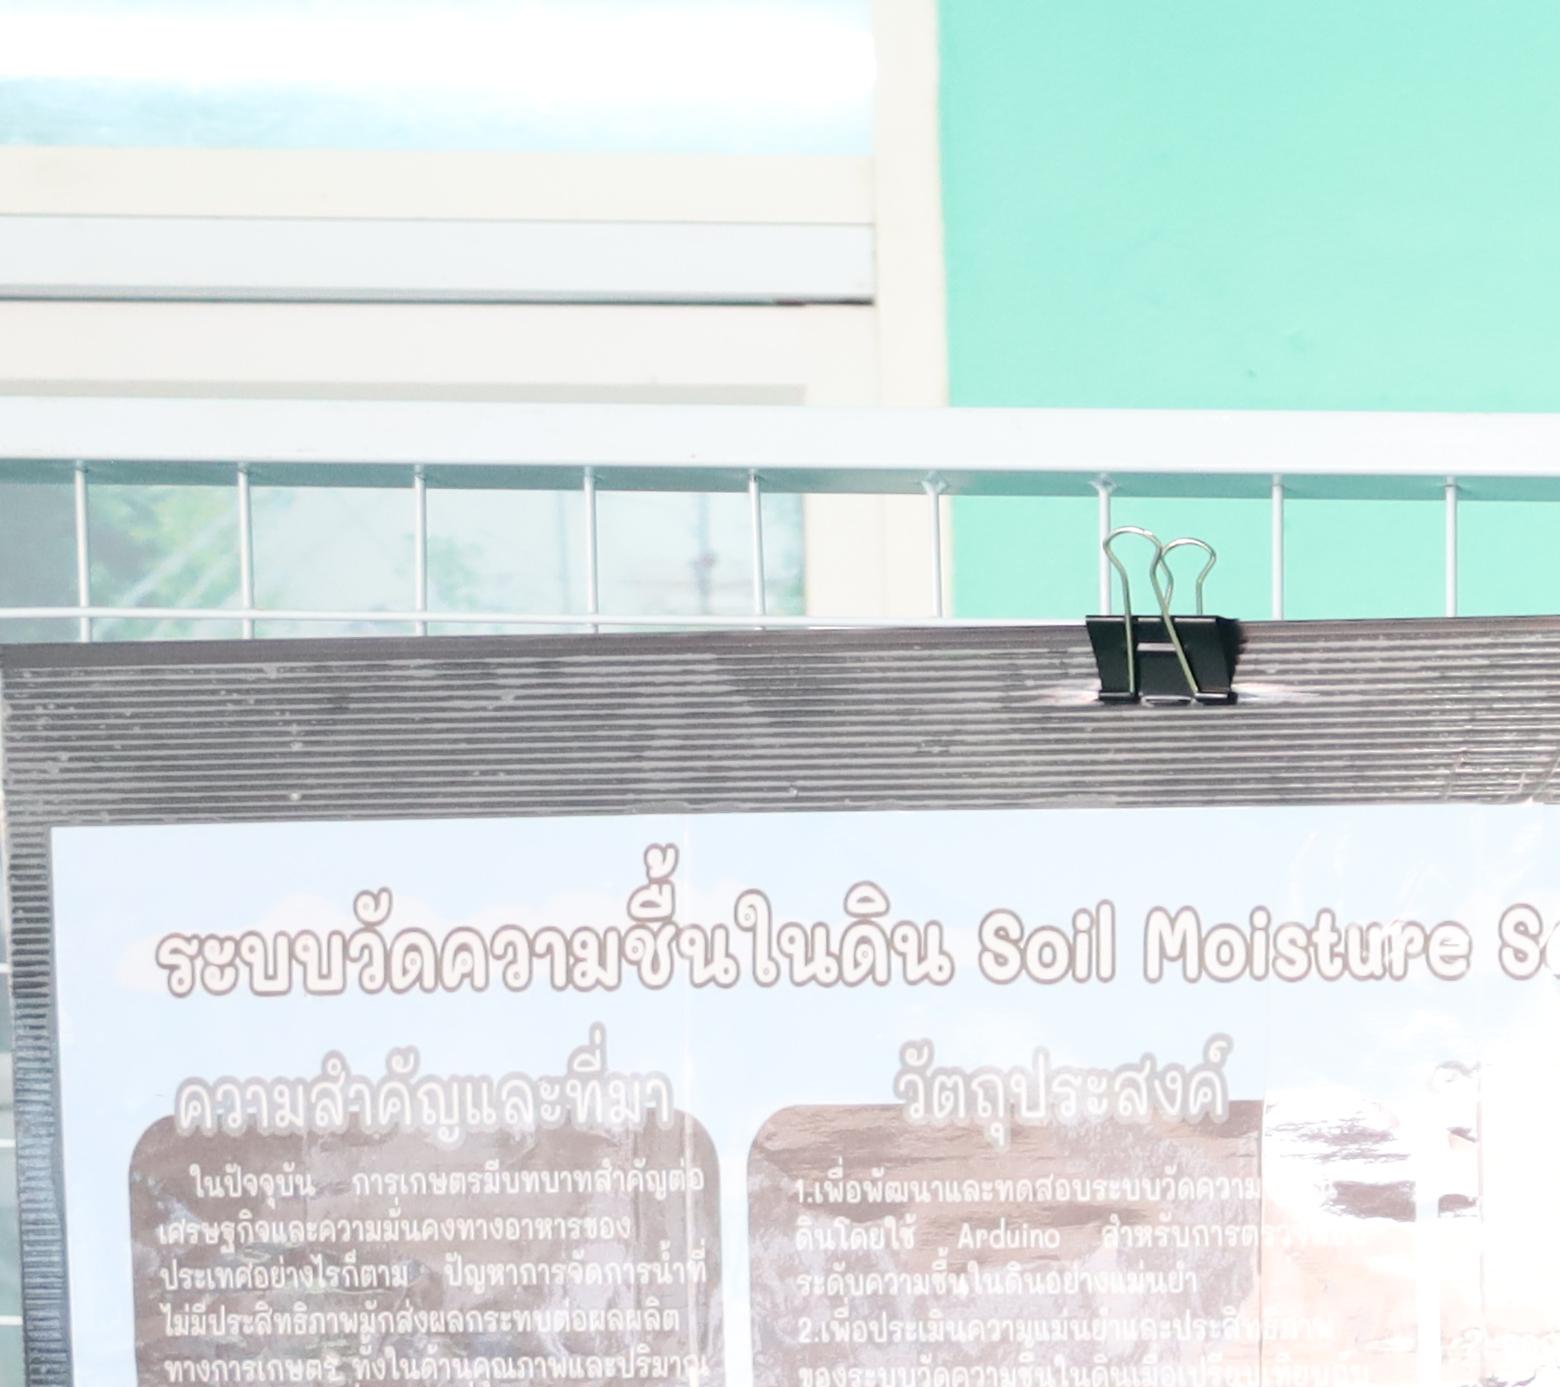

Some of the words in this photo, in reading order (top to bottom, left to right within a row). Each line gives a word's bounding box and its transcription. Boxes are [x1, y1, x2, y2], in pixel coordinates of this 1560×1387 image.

[155, 843, 955, 997] ระบบวัดความชื้นในดิน
[977, 898, 1115, 983] Soil
[1142, 903, 1474, 983] Moisture
[175, 1024, 676, 1151] ความสำคัญและที่มา
[895, 1033, 1234, 1152] วัตถุประสงค์
[190, 1164, 316, 1208] ในปัจจุบัน
[957, 1216, 1061, 1250] Arduino
